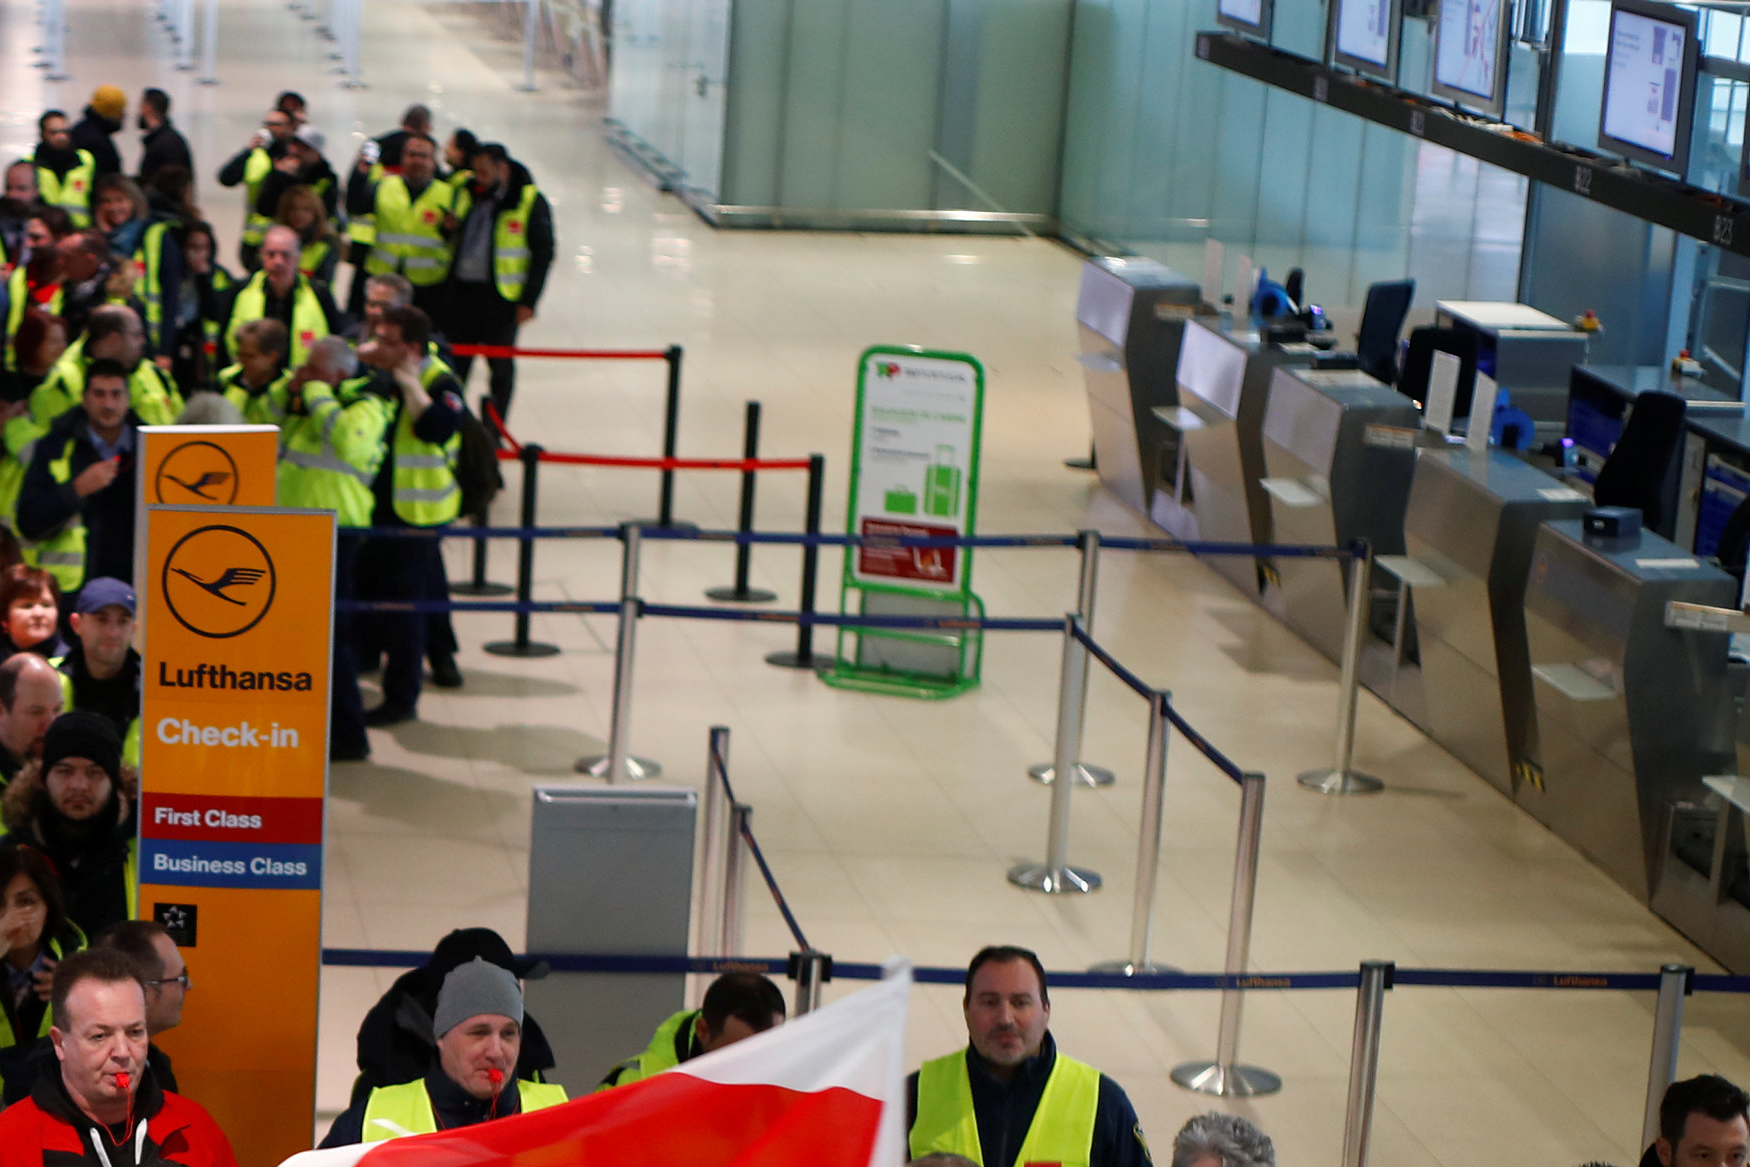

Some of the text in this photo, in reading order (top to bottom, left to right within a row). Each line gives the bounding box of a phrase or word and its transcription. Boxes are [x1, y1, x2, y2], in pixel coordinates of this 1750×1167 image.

[159, 661, 312, 691] Lufthansa
[156, 717, 299, 748] Check-in
[154, 807, 262, 829] First Class
[153, 853, 307, 876] Business Class
[1236, 976, 1291, 989] Lufthansa
[1553, 975, 1607, 987] Lufthansa
